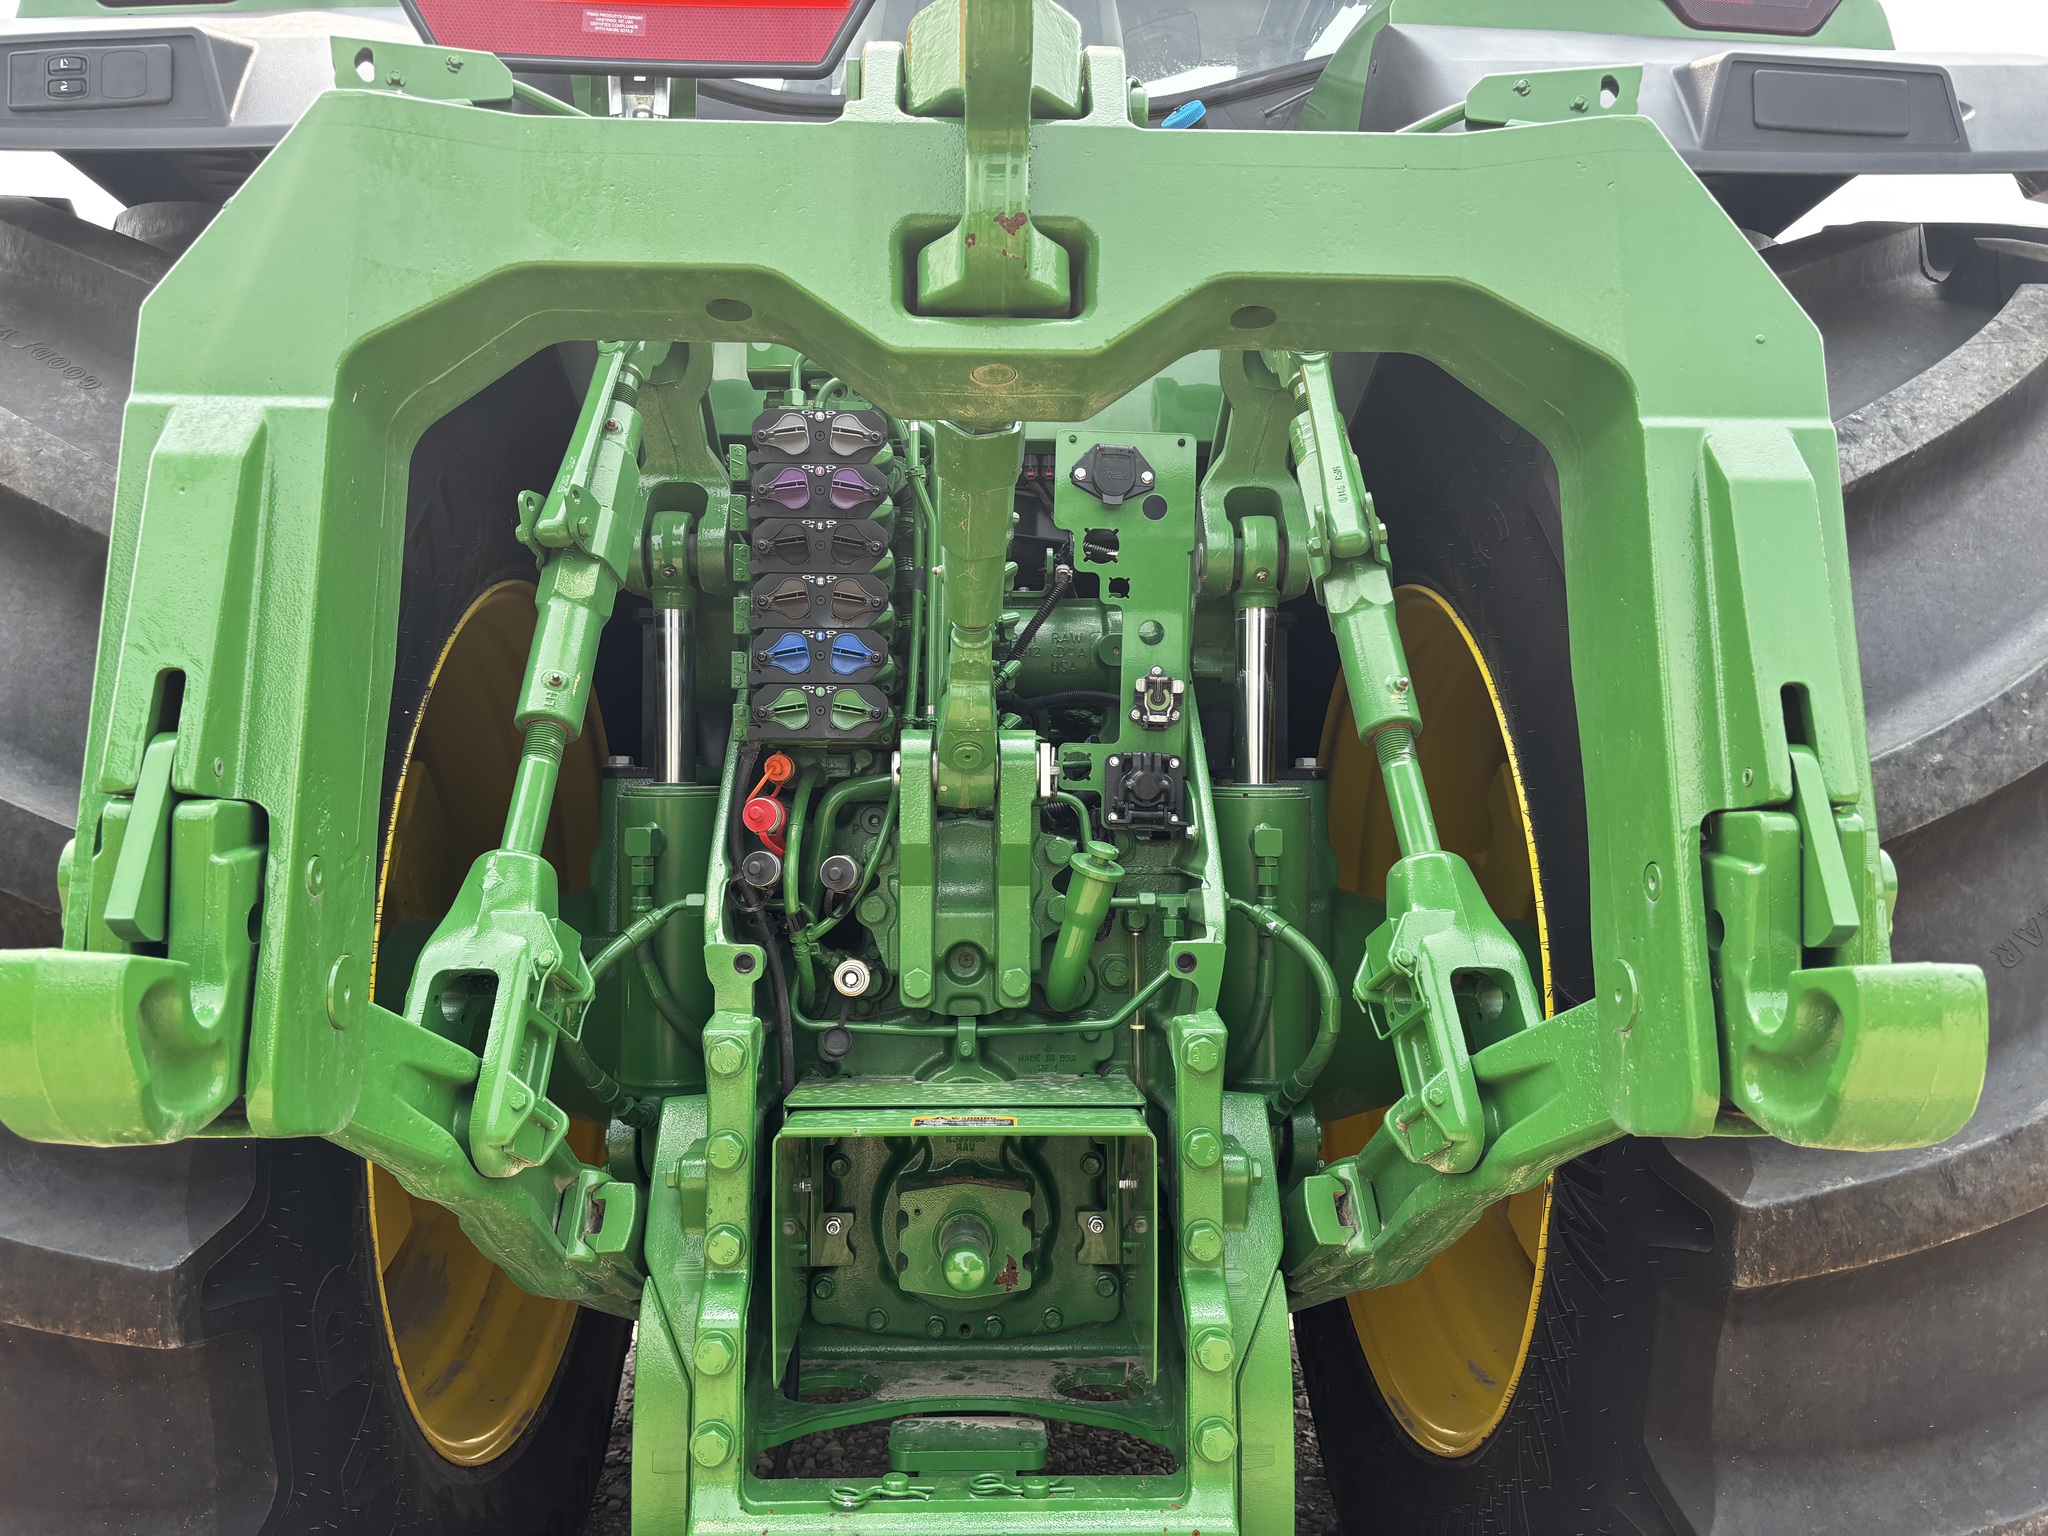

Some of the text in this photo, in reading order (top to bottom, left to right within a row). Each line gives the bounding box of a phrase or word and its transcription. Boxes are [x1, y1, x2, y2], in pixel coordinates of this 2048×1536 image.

[1050, 632, 1083, 645] RAW
[1050, 661, 1078, 674] USA
[1018, 1053, 1077, 1062] MADE IN USA
